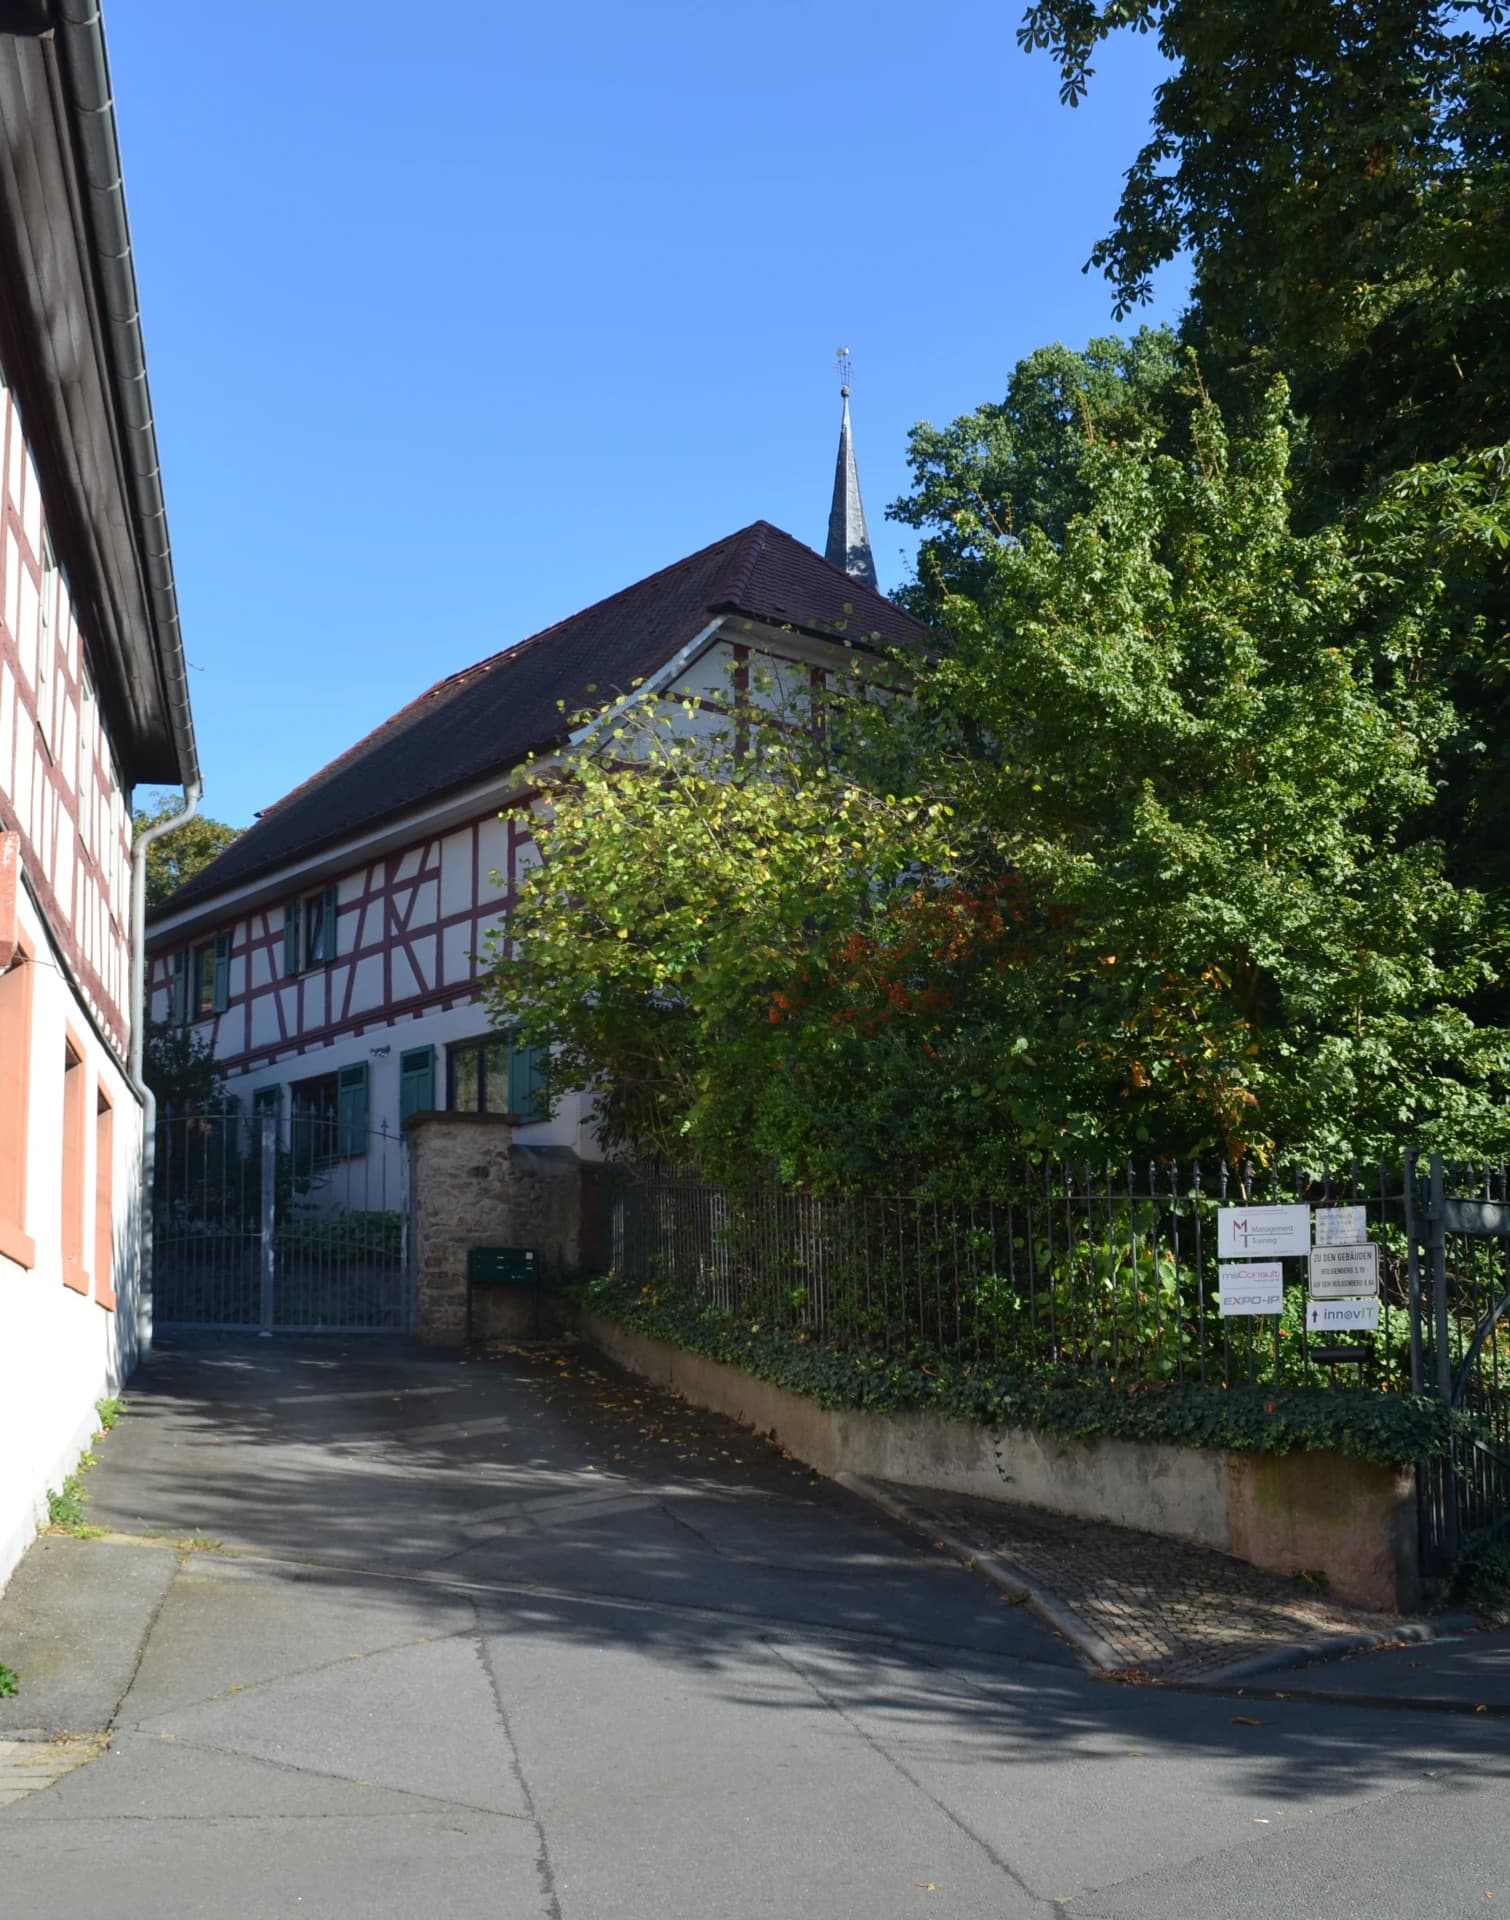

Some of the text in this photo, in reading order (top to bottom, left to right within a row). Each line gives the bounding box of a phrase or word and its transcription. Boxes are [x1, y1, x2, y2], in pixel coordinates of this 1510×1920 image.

[1251, 1224, 1295, 1234] Management
[1252, 1237, 1278, 1245] Training
[1313, 1250, 1372, 1263] ZU DEN GEBÄUDEN
[1223, 1295, 1281, 1306] EXPO-IP
[1323, 1306, 1375, 1320] innovIT
